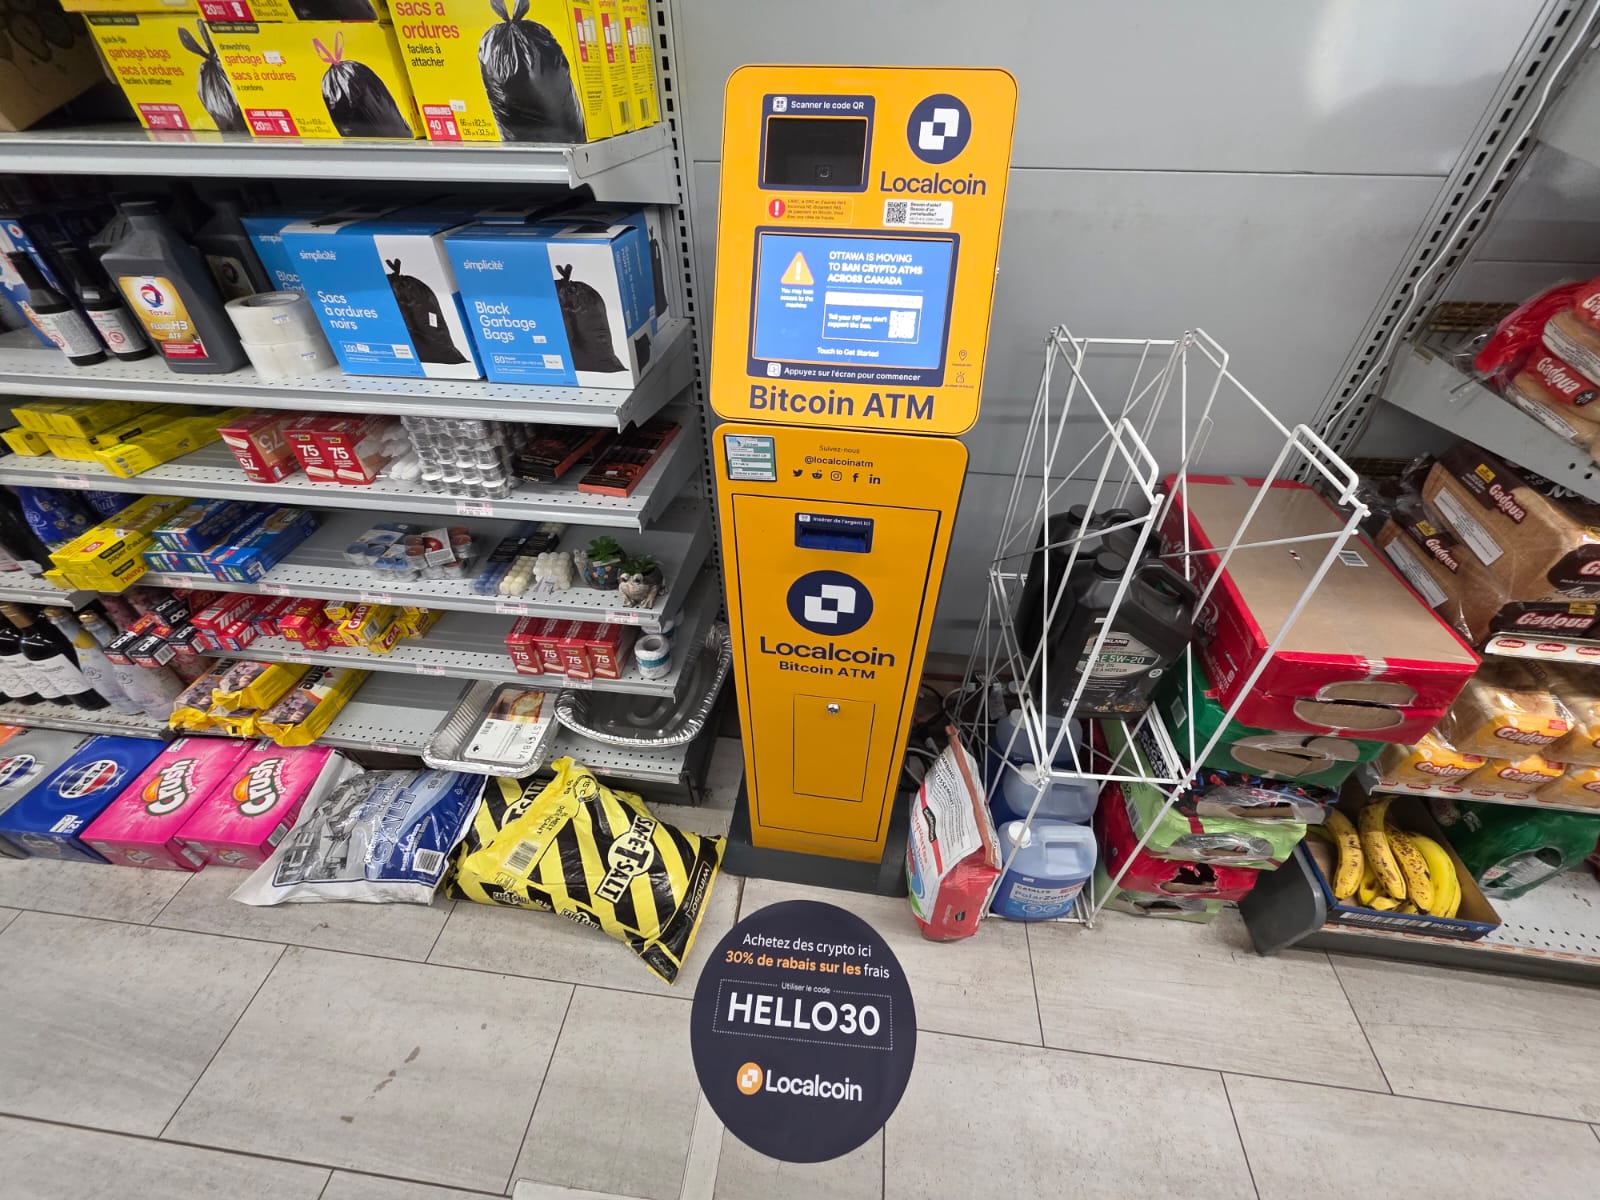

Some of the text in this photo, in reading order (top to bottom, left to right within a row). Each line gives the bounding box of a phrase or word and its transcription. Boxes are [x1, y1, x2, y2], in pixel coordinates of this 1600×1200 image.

[396, 1, 431, 16] sacs
[402, 20, 460, 39] ordures
[108, 47, 171, 61] garbage bags
[407, 43, 433, 54] faciles
[224, 53, 261, 66] garbage
[411, 57, 445, 67] attacher
[118, 66, 140, 76] sacs
[148, 64, 184, 76] ordures
[231, 72, 253, 81] sacs
[261, 70, 297, 81] ordures
[791, 100, 864, 111] Scanner le code QR
[429, 119, 442, 131] 40
[880, 171, 987, 196] Localcoin
[829, 251, 913, 264] OTTAWA IS MOVING
[828, 262, 841, 272] TO
[841, 263, 861, 273] BAN
[861, 263, 897, 275] CRYPTO
[276, 270, 300, 283] Blac
[827, 273, 903, 286] ACROSS CANADA
[317, 290, 347, 304] Sacs
[325, 304, 378, 319] à ordures
[474, 300, 510, 315] Black
[330, 317, 358, 331] noirs
[479, 315, 537, 332] Garbage
[482, 327, 516, 345] Bags
[784, 367, 921, 382] Appuyez sur l'écran pour commencer
[1536, 356, 1581, 395] Gadoua
[749, 384, 935, 420] Bitcoin ATM
[296, 444, 320, 457] 75
[327, 447, 350, 460] 75
[804, 455, 874, 468] @localcoinatm
[1488, 483, 1526, 523] Gadoua
[1425, 537, 1459, 572] Gadoua
[214, 601, 252, 630] TITAN
[347, 606, 368, 629] GLAD
[1515, 611, 1595, 630] Gadoua
[385, 625, 400, 646] GLA
[513, 652, 529, 661] 75
[541, 649, 558, 659] 75
[594, 654, 610, 664] 75
[759, 635, 896, 668] Localcoin
[566, 655, 582, 665] 75
[1109, 655, 1145, 664] 5W-20
[779, 660, 876, 680] Bitcoin ATM
[1496, 725, 1558, 746] Gadou
[66, 761, 110, 796] PEPSI
[147, 758, 193, 815] Crush
[239, 758, 280, 815] Crush
[742, 933, 872, 958] Achetez des crypto ici
[725, 949, 890, 979] 30% de rabais sur les frais
[781, 982, 831, 994] Utiliser le code
[727, 991, 881, 1037] HELLO30
[765, 1069, 863, 1102] Localcoin
